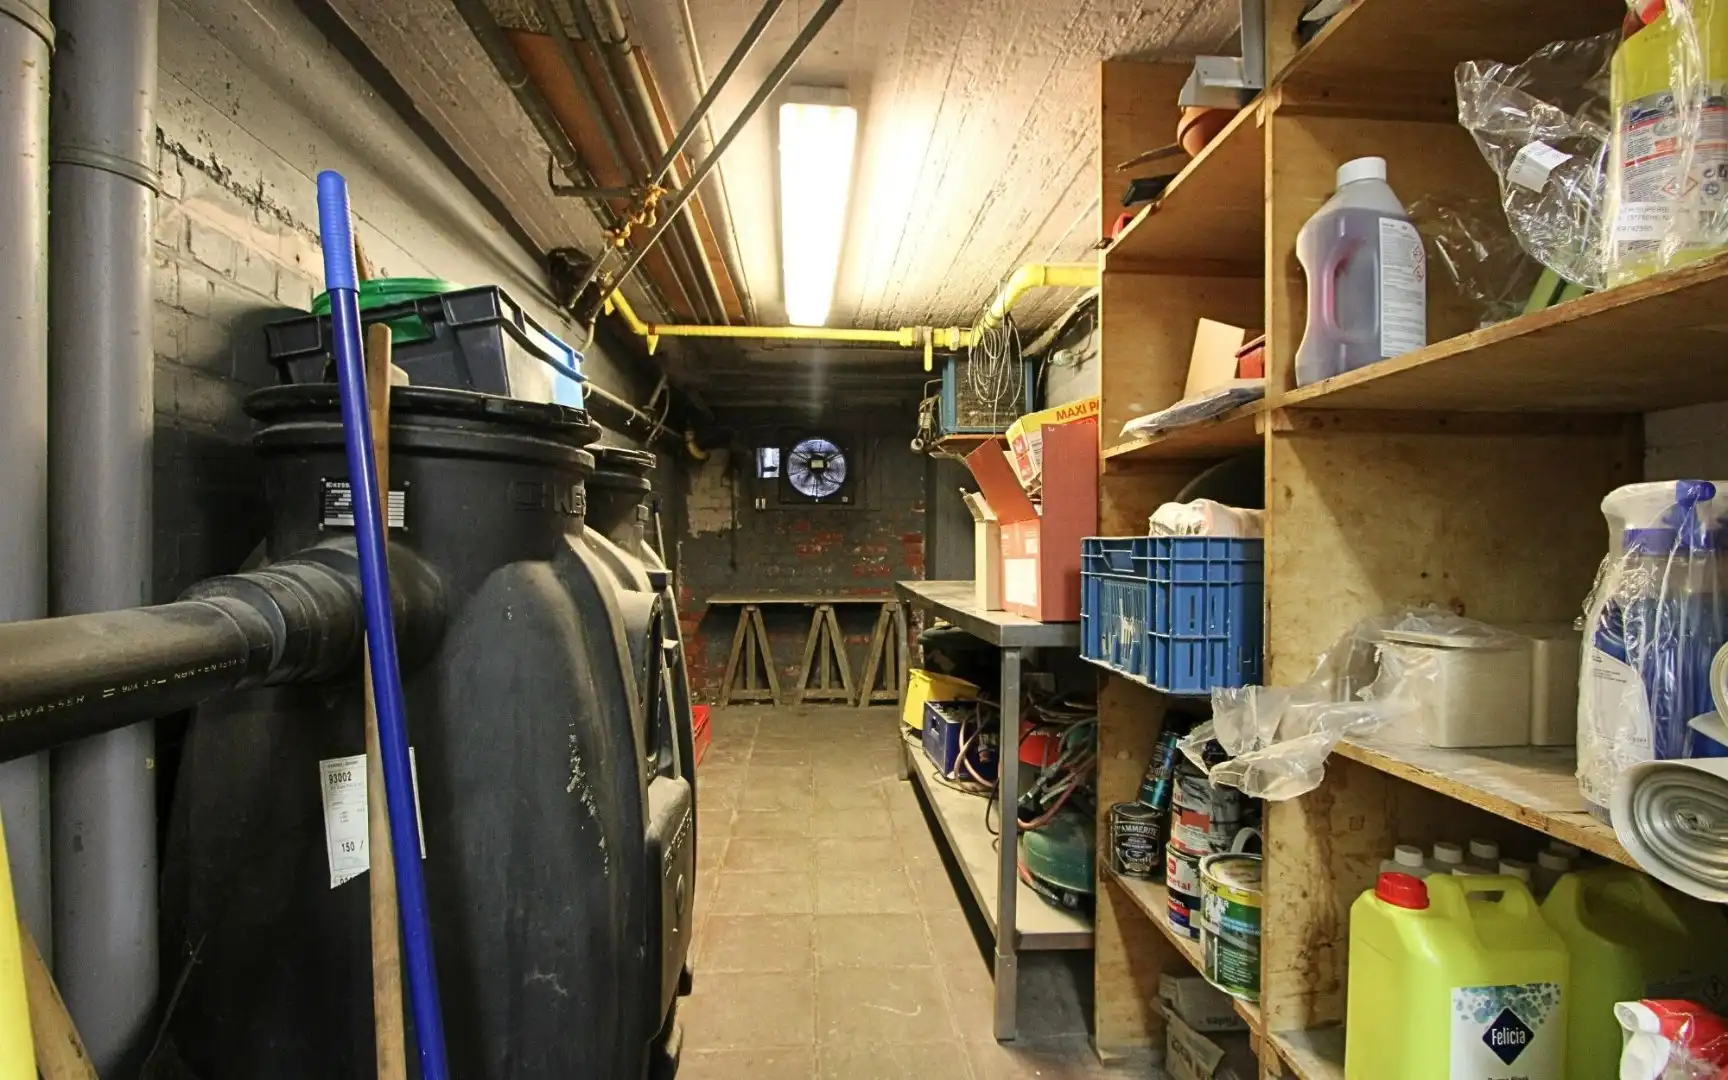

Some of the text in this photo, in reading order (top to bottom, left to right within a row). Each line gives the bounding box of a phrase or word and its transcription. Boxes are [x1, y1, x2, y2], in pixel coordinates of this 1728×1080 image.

[1056, 403, 1087, 421] MAXI
[329, 771, 352, 784] 93002
[341, 842, 355, 853] 150
[1491, 1027, 1526, 1046] Felicia
